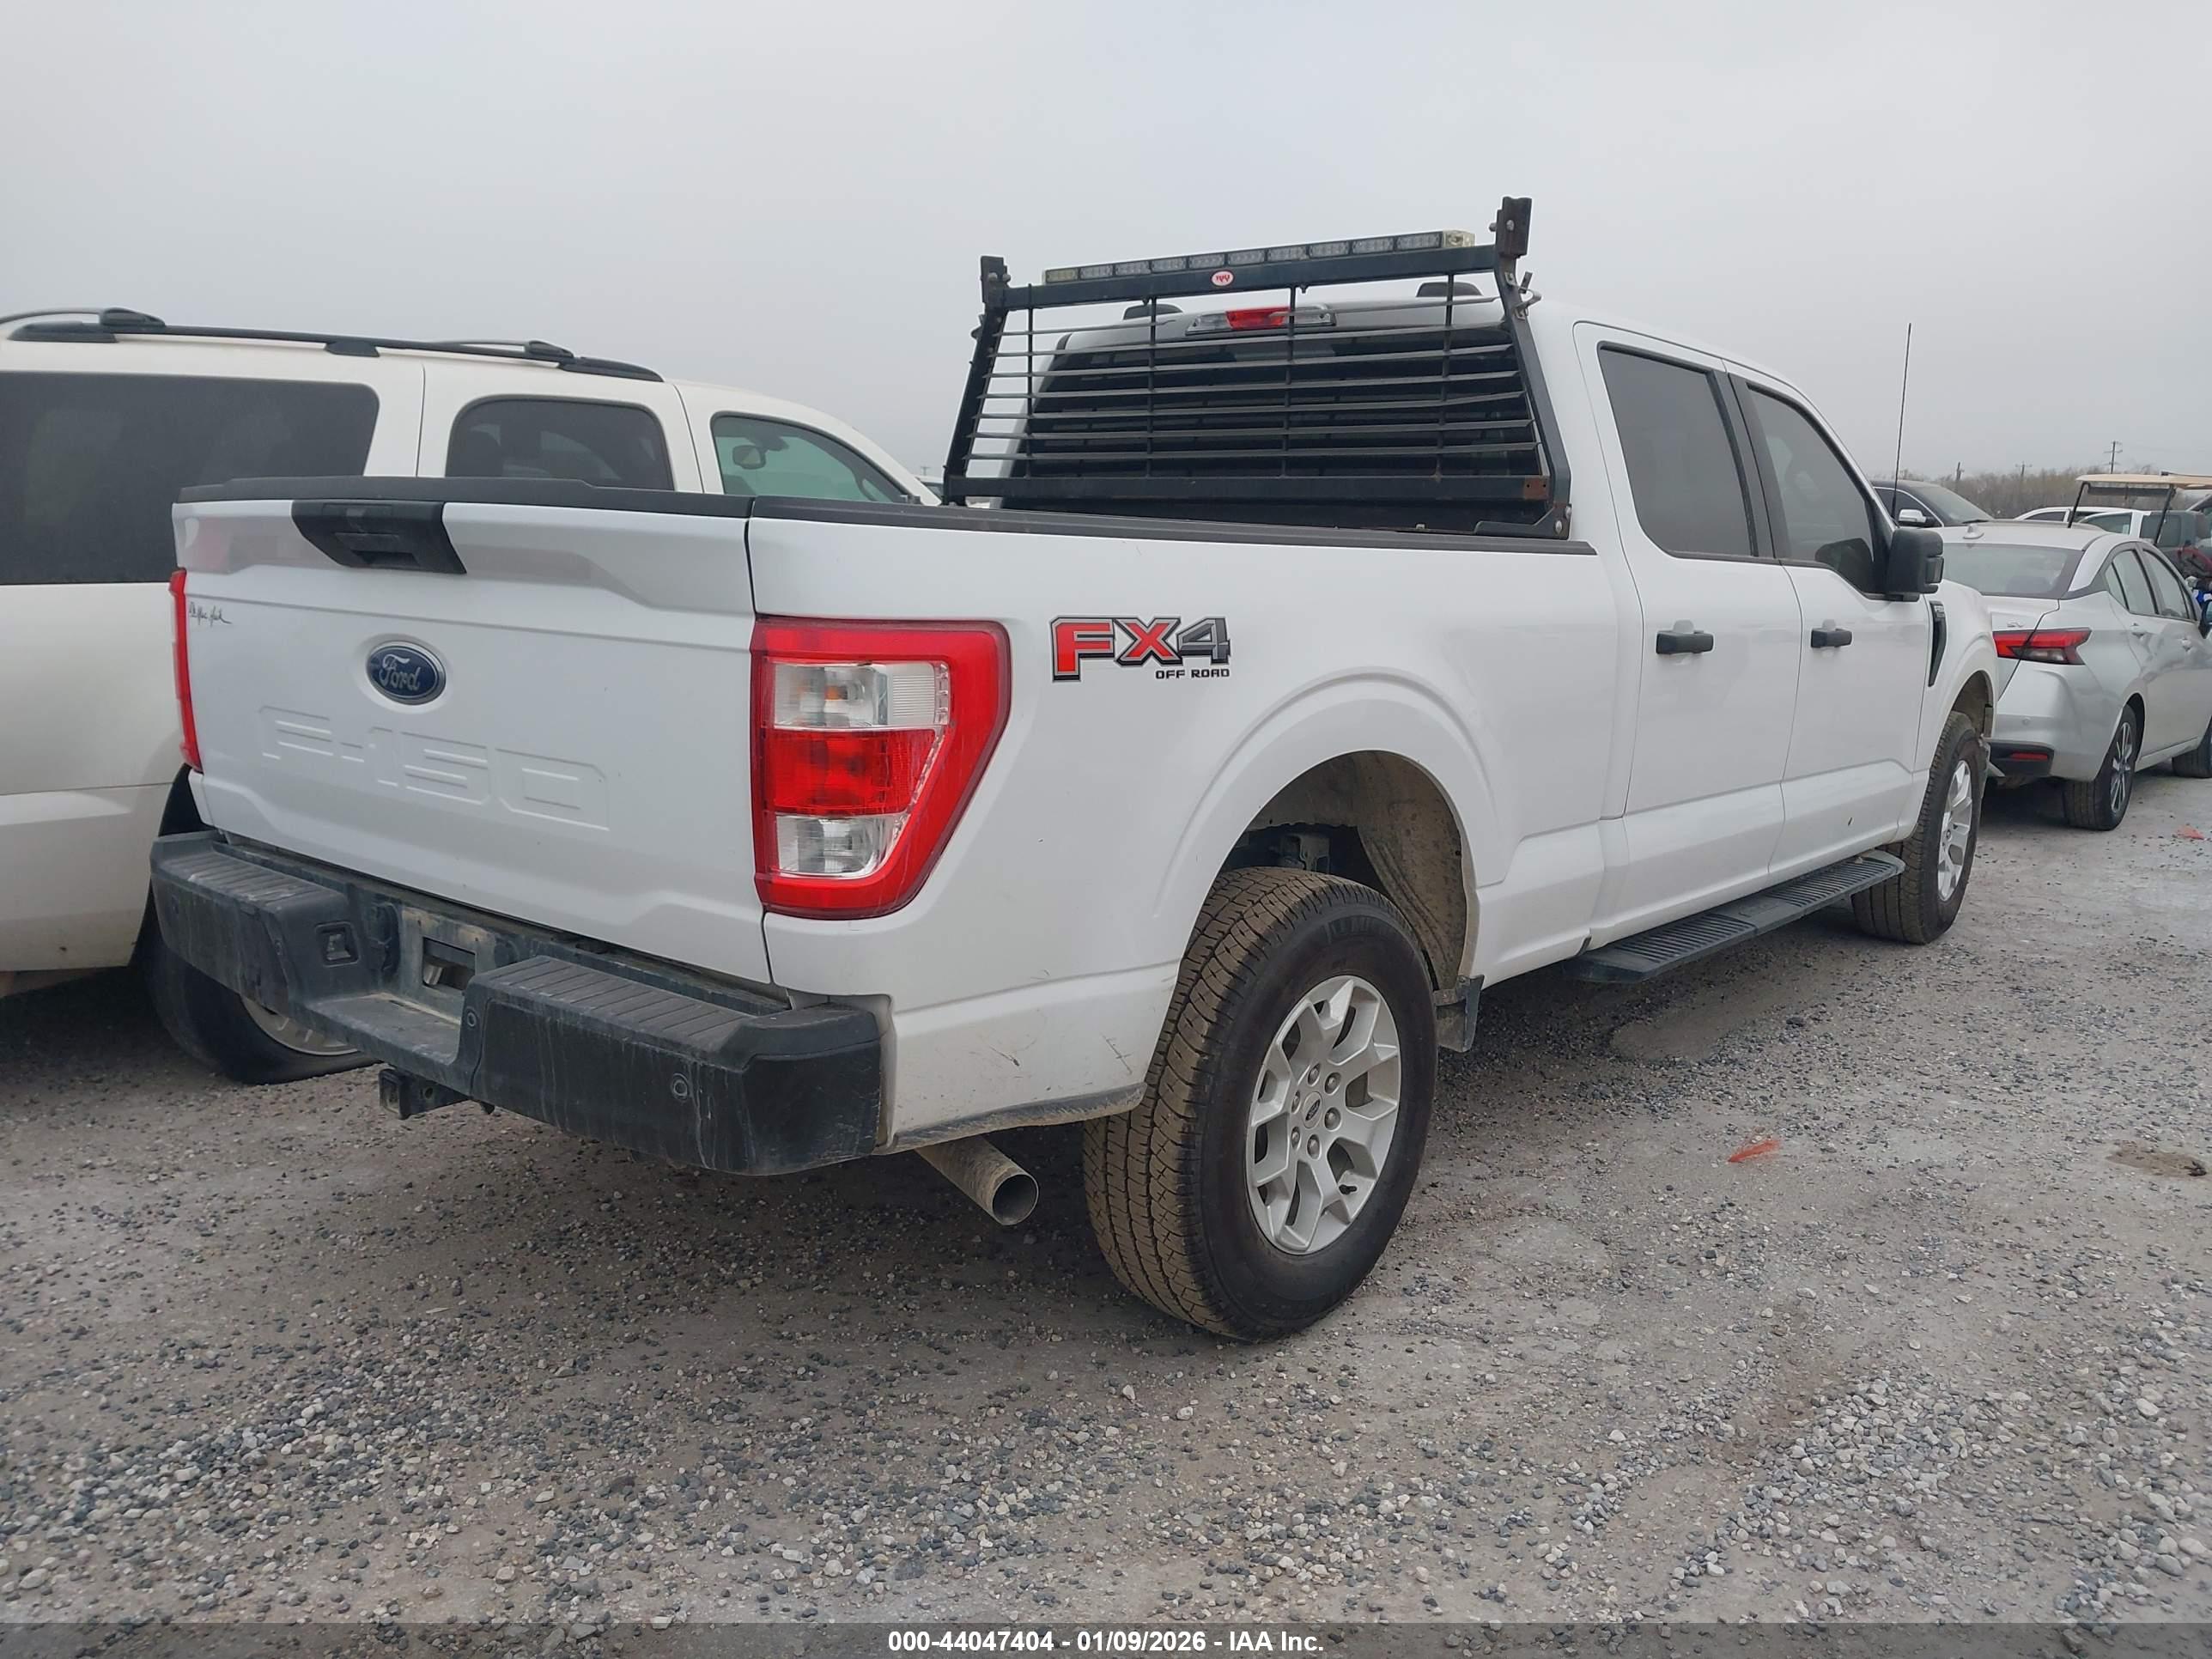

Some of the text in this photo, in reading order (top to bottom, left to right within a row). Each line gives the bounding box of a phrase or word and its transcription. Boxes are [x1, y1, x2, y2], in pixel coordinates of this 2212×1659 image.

[379, 653, 421, 690] Ford
[1049, 616, 1231, 682] FX4
[1155, 668, 1230, 679] OFF ROAD
[259, 706, 610, 831] F-150
